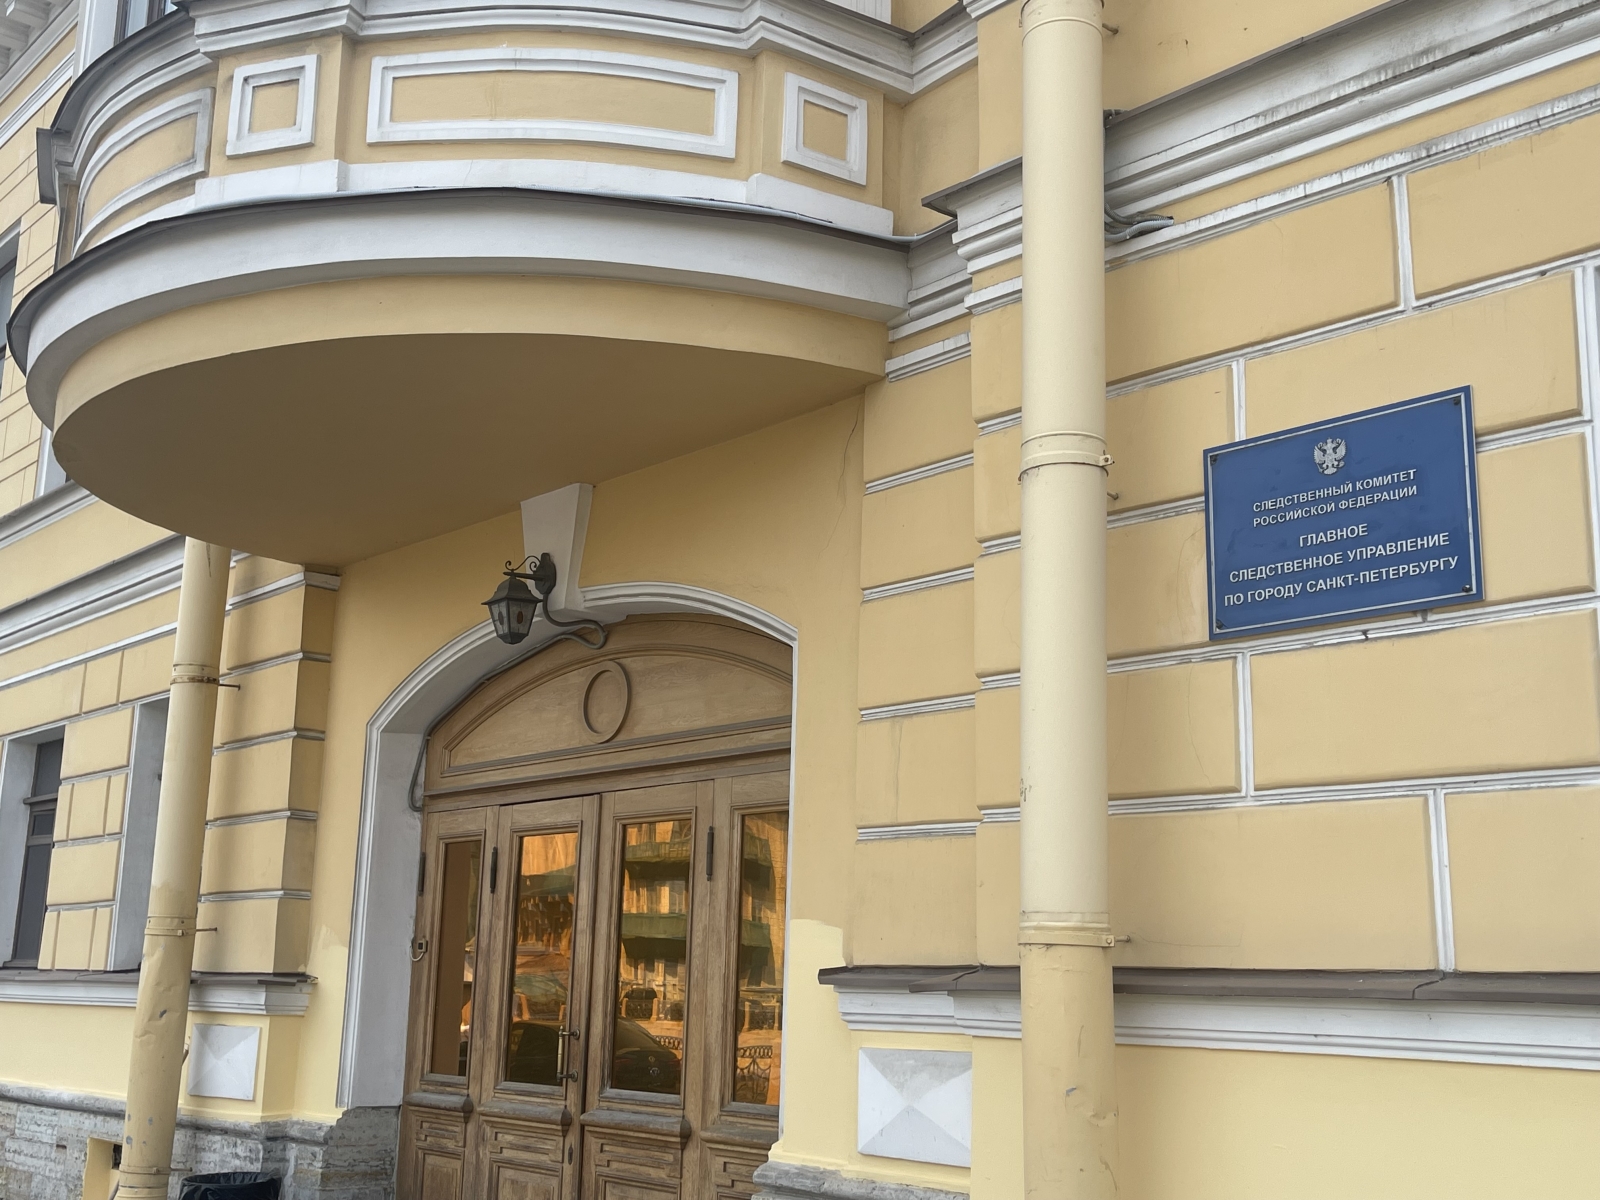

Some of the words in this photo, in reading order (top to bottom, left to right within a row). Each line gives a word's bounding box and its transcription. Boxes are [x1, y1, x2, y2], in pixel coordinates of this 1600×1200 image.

[1253, 480, 1354, 512] СЛЕДСТВЕННЫЙ
[1355, 468, 1417, 491] КОМИТЕТ
[1253, 500, 1336, 528] РОССИЙСКОЙ
[1338, 485, 1418, 510] ФЕДЕРАЦИИ
[1229, 551, 1344, 583] СЛЕДСТВЕННОЕ
[1346, 532, 1450, 563] УПРАВЛЕНИЕ
[1299, 523, 1369, 548] ГЛАВНОЕ
[1224, 593, 1244, 607] ПО
[1247, 582, 1303, 603] ГОРОДУ
[1306, 555, 1459, 593] САНКТ-ПЕТЕРБУРГУ
